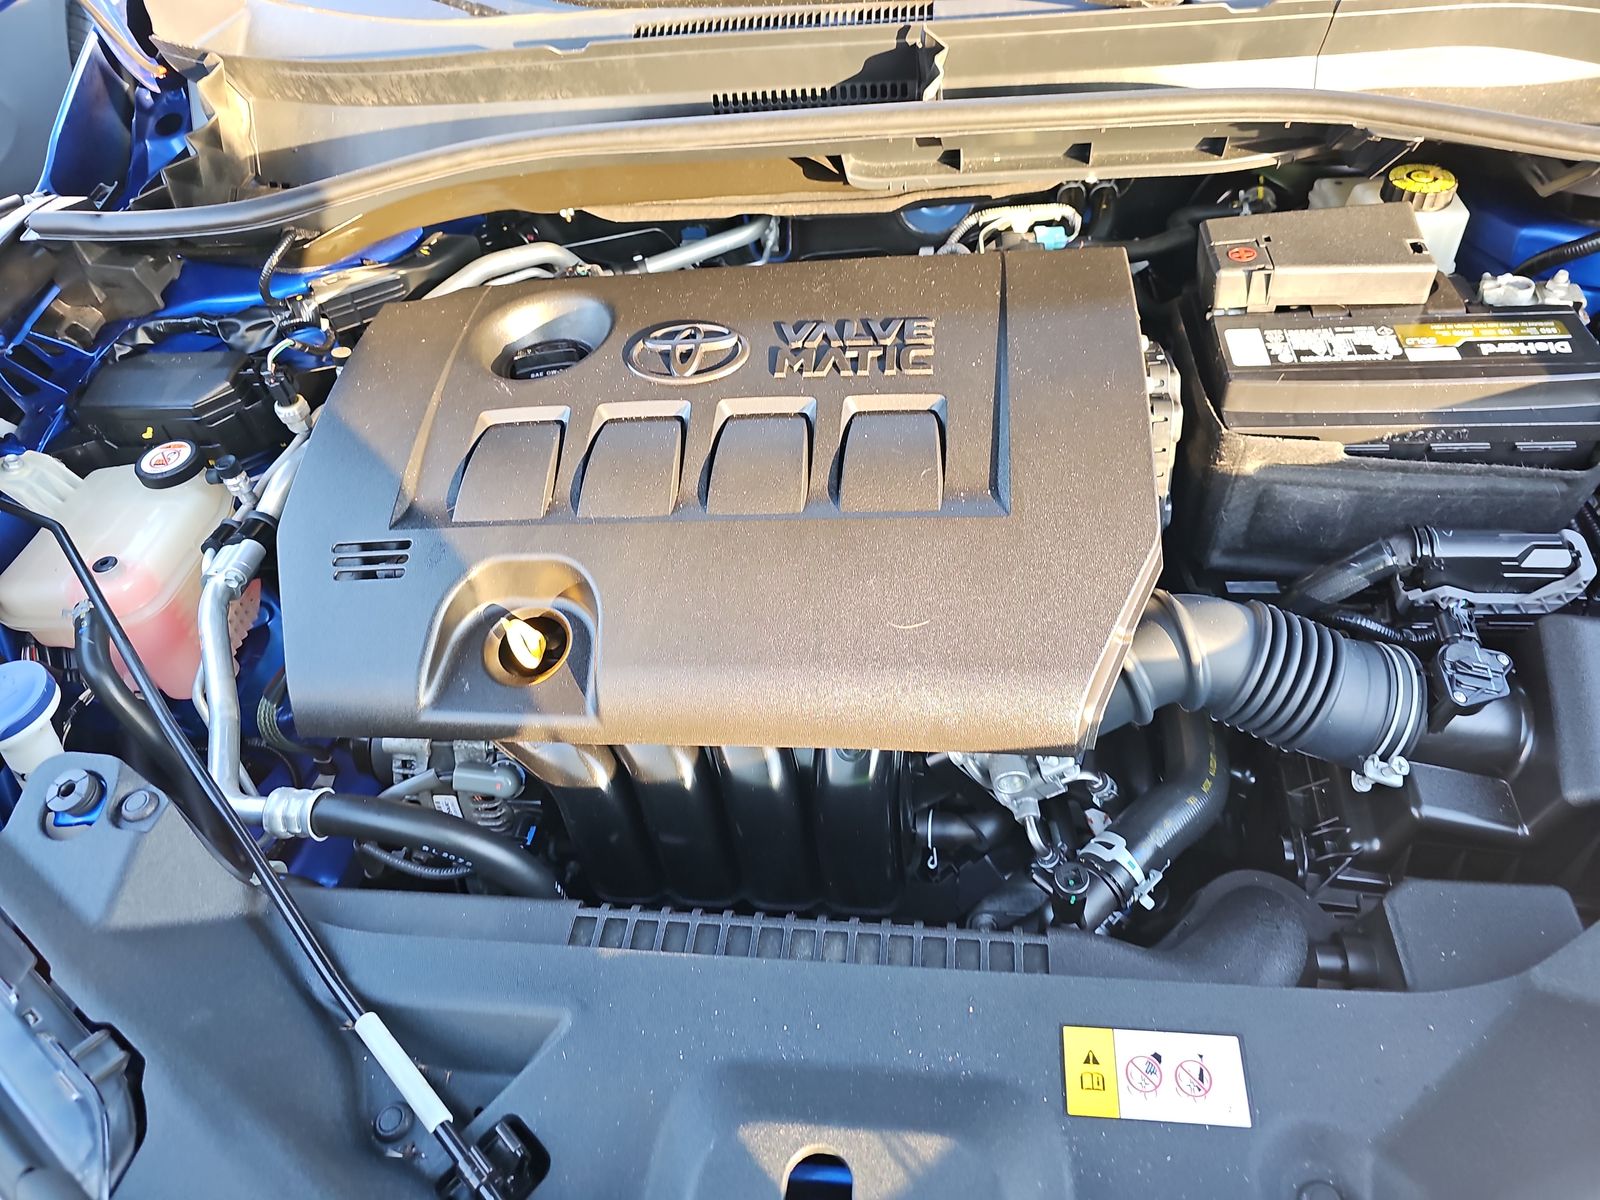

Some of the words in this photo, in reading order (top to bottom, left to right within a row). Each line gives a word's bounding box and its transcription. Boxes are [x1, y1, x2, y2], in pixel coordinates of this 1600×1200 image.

[775, 317, 935, 347] VALVE
[769, 346, 935, 378] MATIC
[1479, 341, 1573, 356] DieHard
